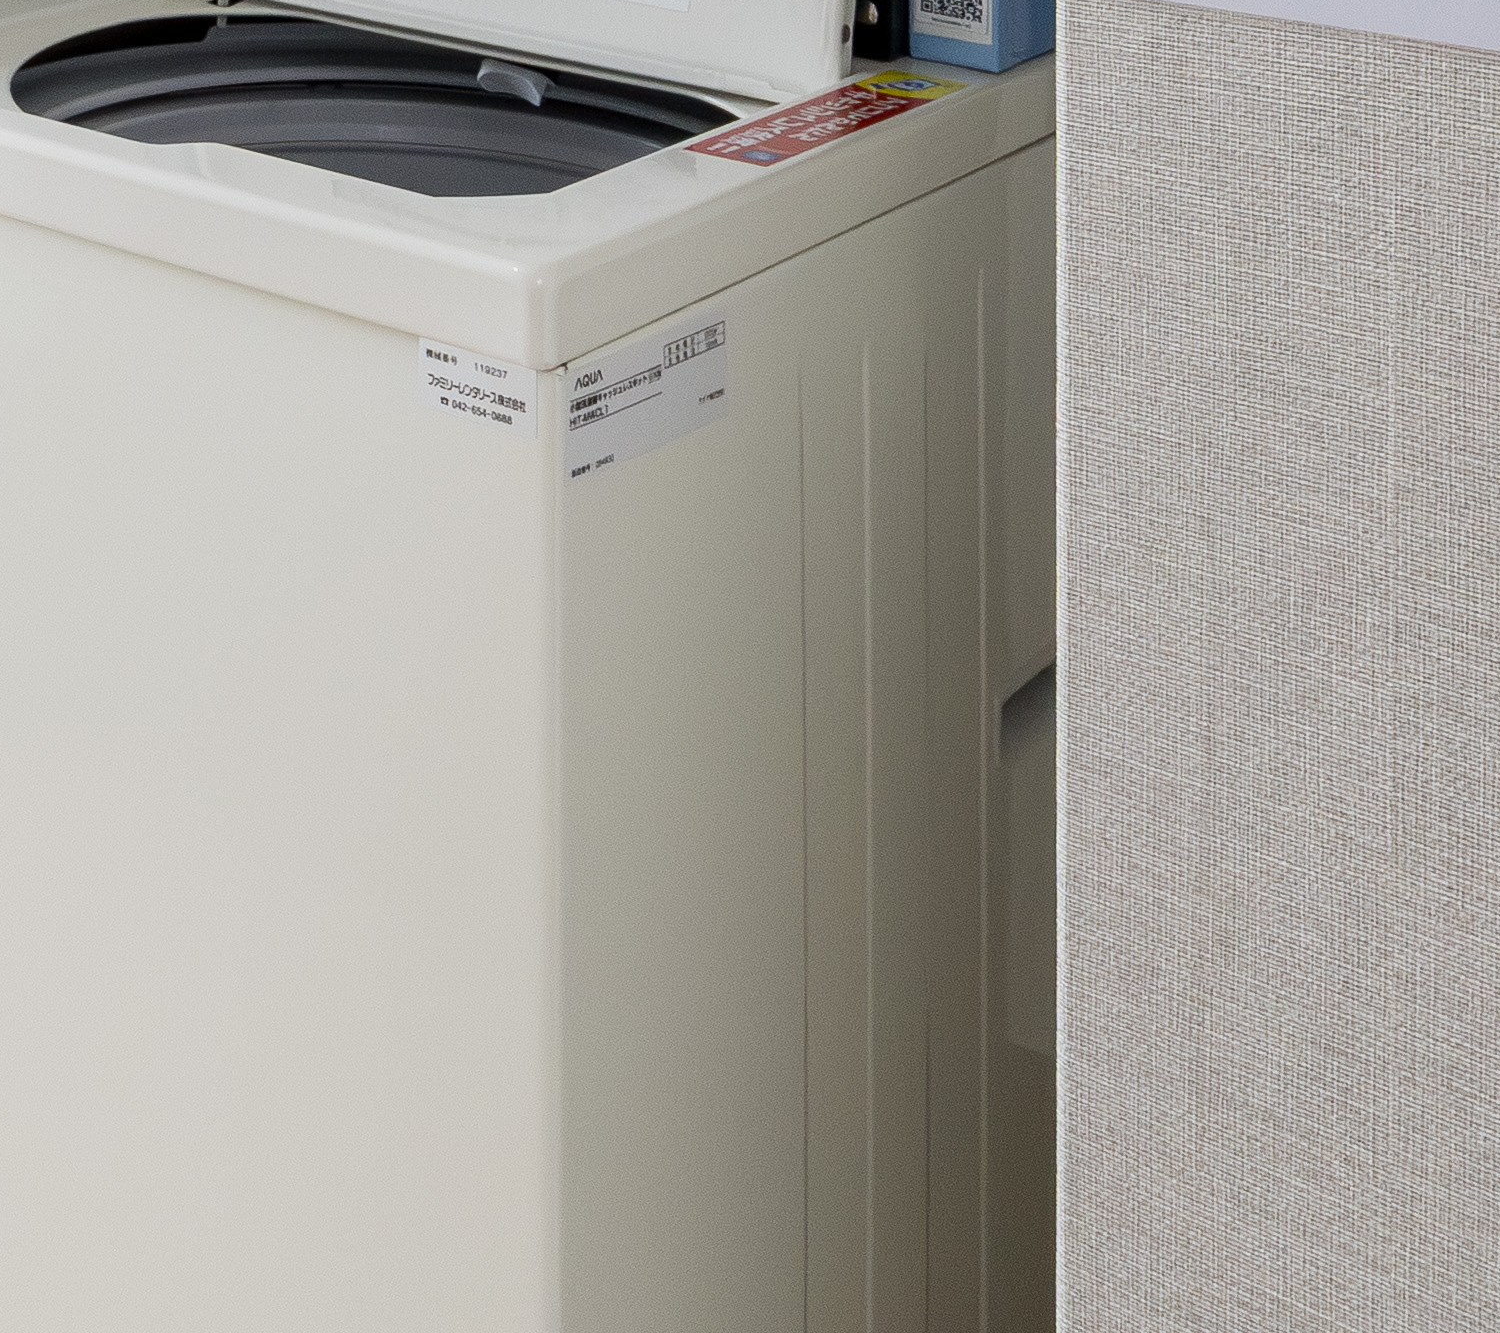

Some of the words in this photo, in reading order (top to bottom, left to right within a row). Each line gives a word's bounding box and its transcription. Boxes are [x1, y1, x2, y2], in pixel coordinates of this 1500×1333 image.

[427, 372, 527, 414] ファミリーレンタリース株式会社
[573, 369, 604, 392] AQUA
